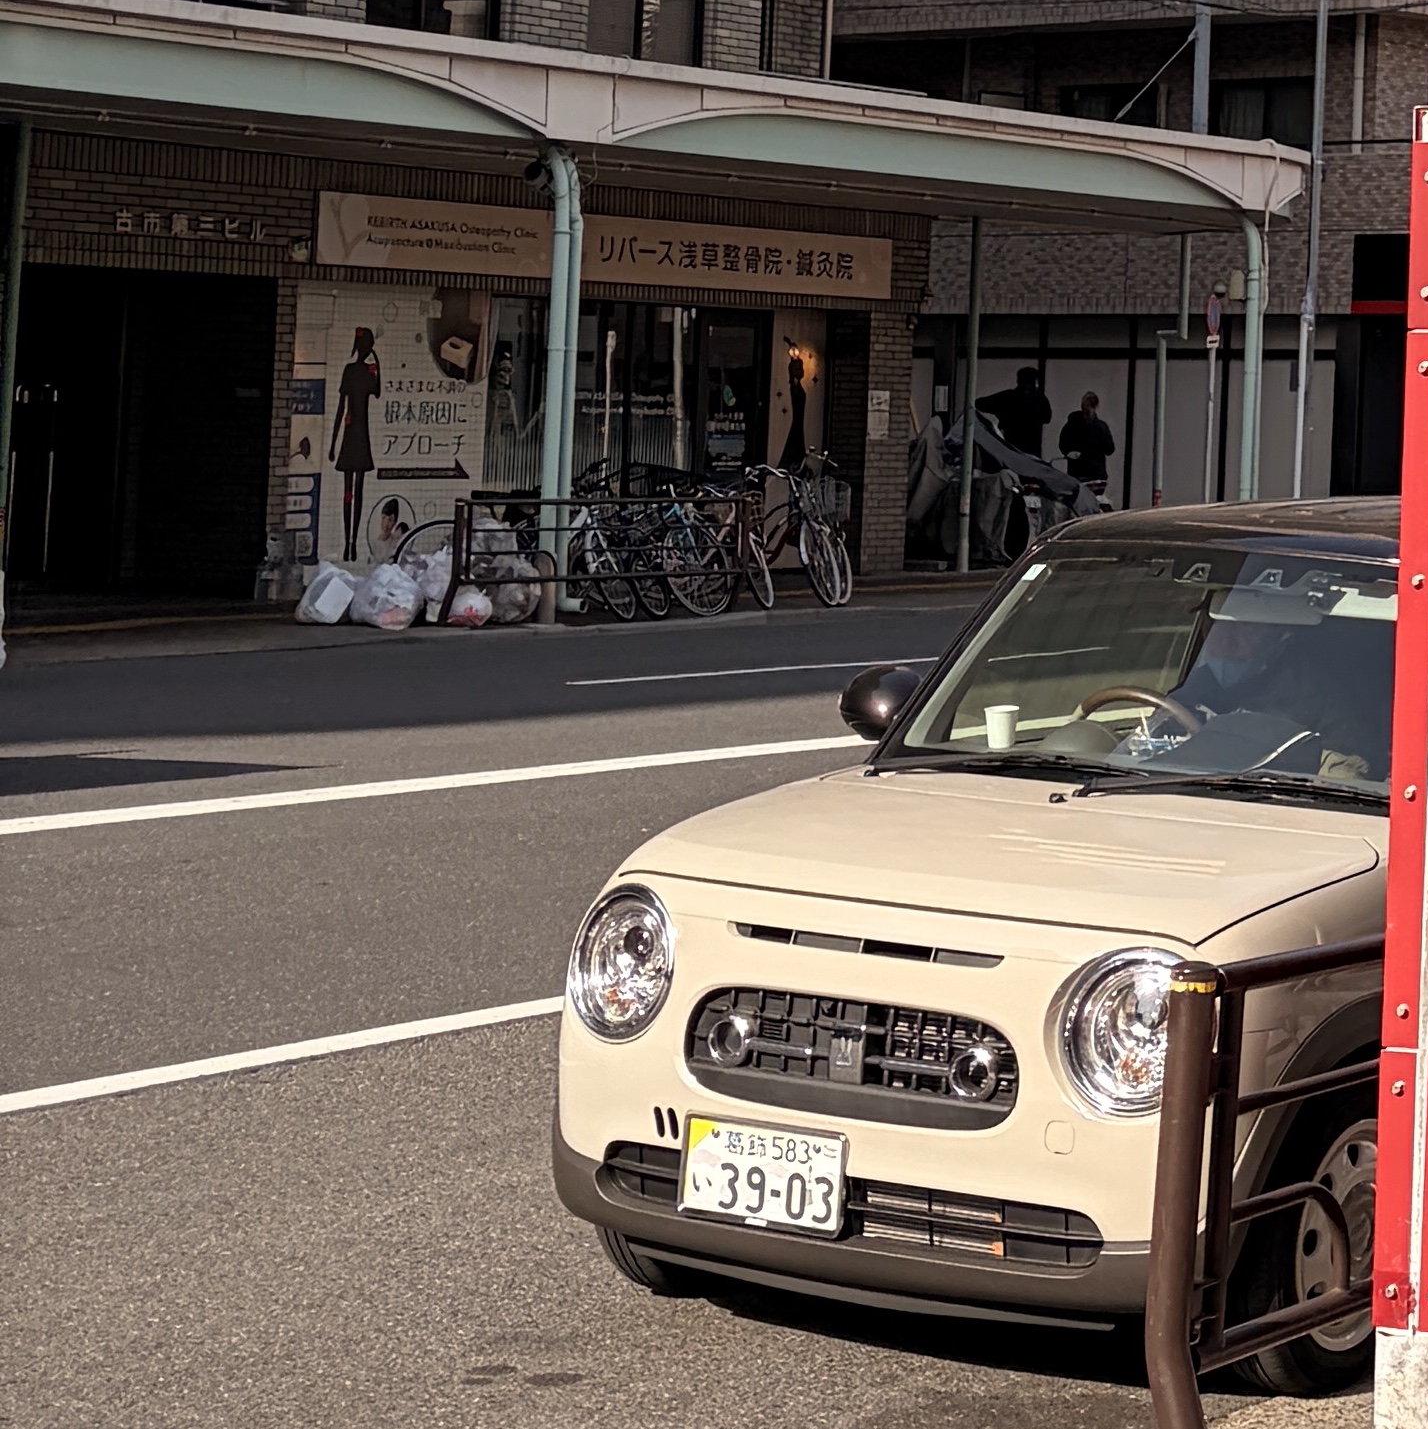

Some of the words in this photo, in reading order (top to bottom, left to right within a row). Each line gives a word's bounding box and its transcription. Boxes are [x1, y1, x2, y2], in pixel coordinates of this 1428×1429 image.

[409, 217, 458, 234] ASAKUSA
[514, 226, 539, 241] Clinic
[491, 240, 517, 255] Clinic
[599, 234, 855, 281] リバース浅草整骨院・鍼灸院
[384, 400, 468, 425] 根本原因に
[382, 431, 467, 456] アプローチ
[771, 1135, 812, 1165] 583
[691, 1171, 713, 1193] い
[717, 1162, 834, 1225] 39-03
